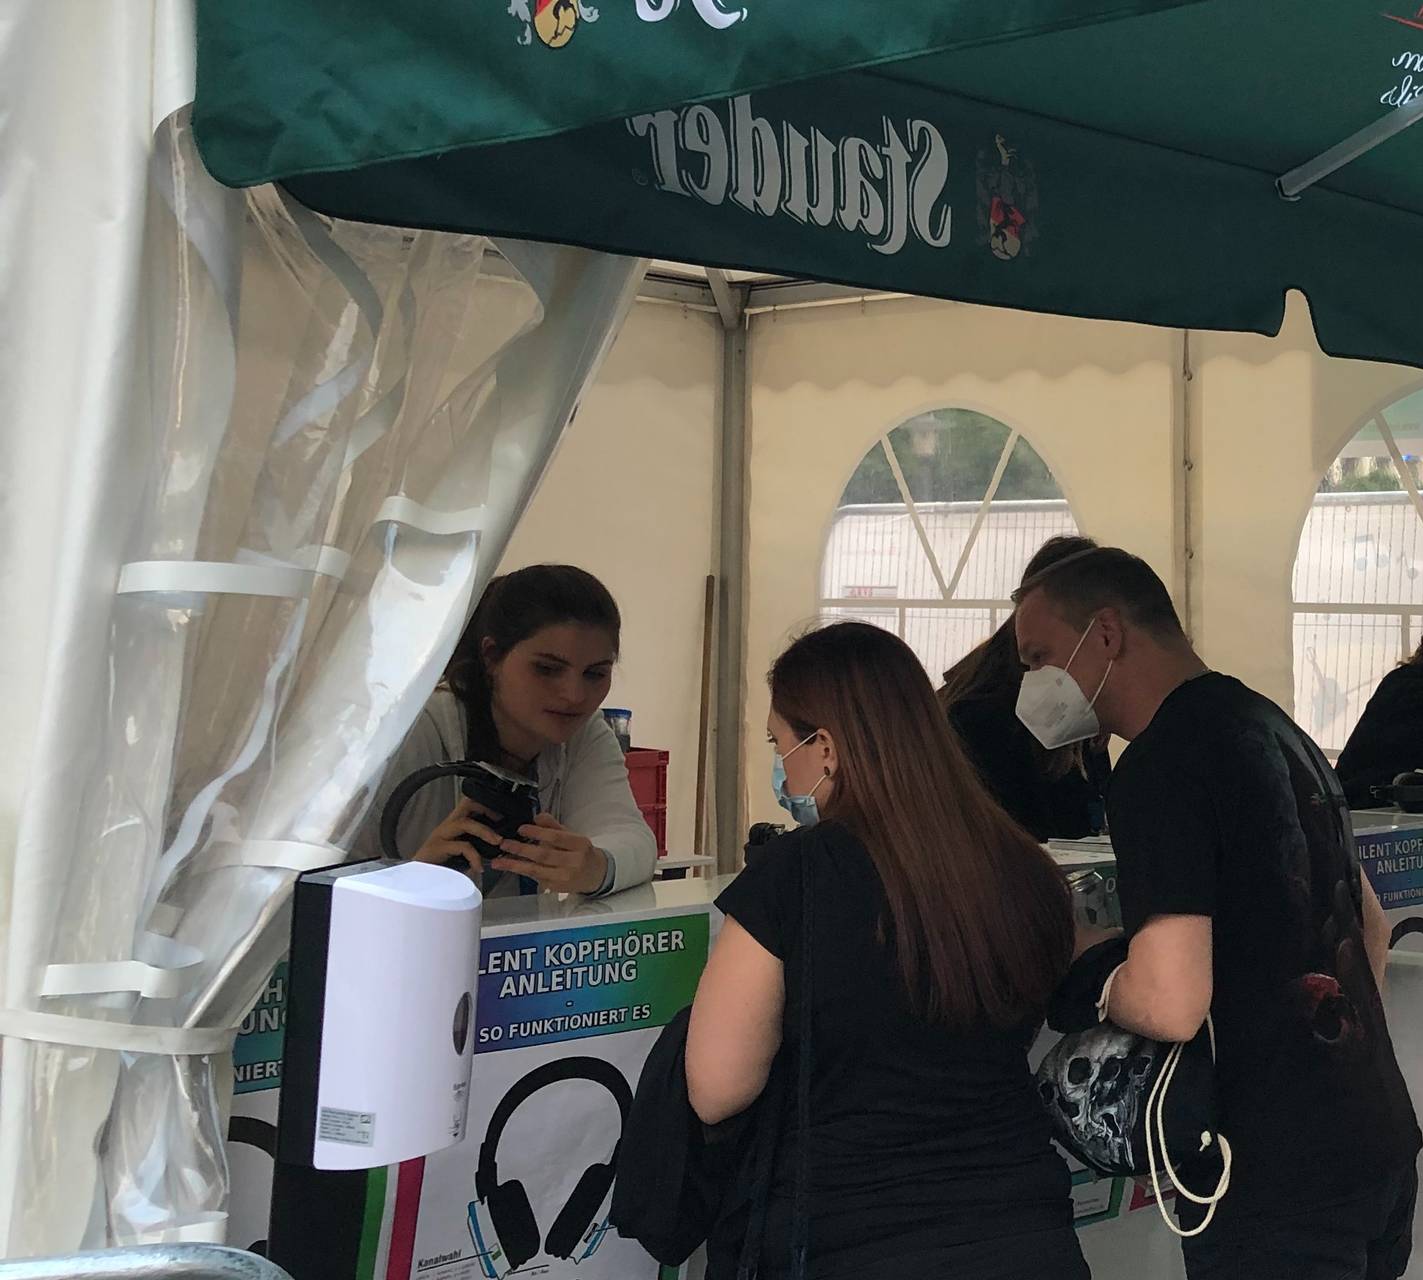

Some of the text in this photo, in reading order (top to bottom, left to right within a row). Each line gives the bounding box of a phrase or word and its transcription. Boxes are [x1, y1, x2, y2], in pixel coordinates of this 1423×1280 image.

[1359, 843, 1391, 859] ILENT
[544, 930, 685, 969] KOPFHÖRER
[498, 960, 638, 999] ANLEITUNG
[479, 1003, 651, 1043] SO FUNKTIONIERT ES
